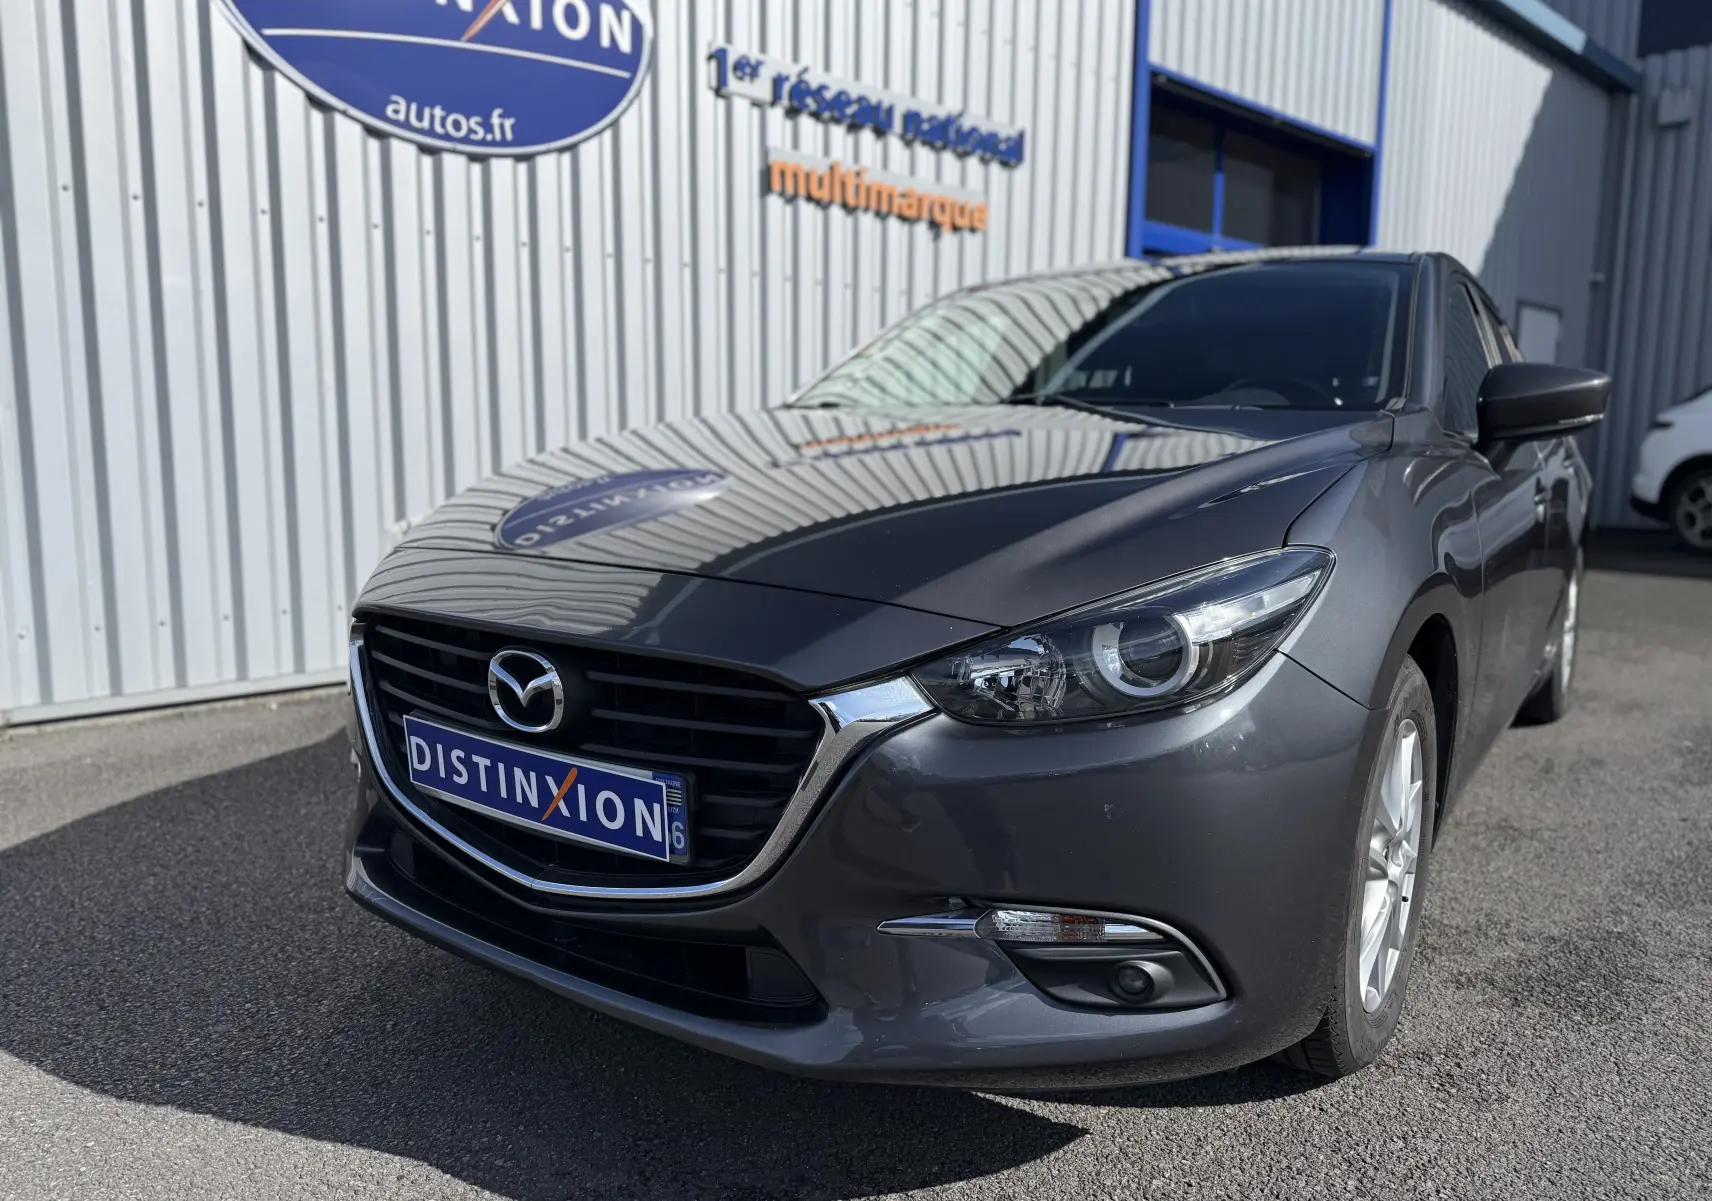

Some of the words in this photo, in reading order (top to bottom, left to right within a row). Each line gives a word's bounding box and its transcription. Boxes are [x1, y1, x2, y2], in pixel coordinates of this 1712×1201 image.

[385, 94, 515, 142] autos.fr
[710, 47, 766, 90] 1er
[774, 66, 893, 131] réseau
[903, 106, 1024, 164] national
[770, 160, 988, 232] multimarque
[409, 735, 663, 842] DISTINXION
[667, 821, 685, 849] 6
